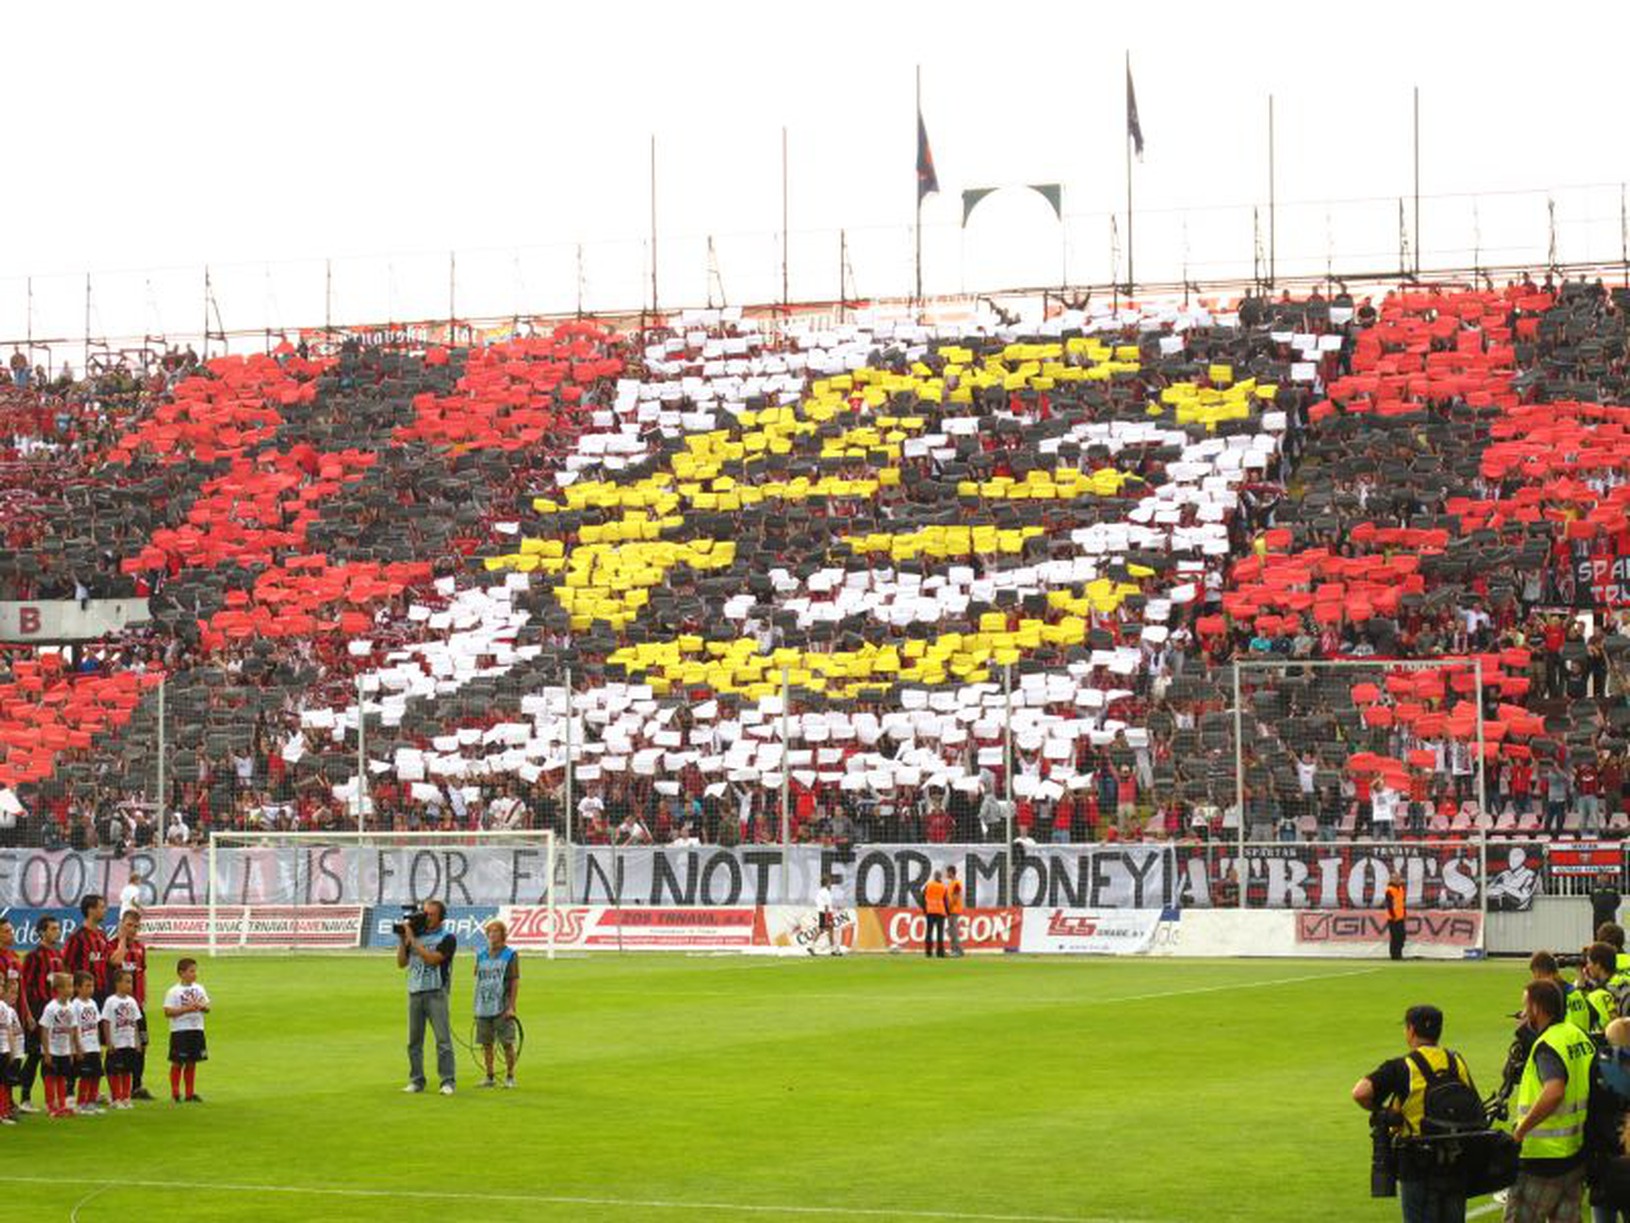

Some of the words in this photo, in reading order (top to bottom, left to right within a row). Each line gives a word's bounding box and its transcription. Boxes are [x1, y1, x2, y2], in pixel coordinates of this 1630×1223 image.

[1578, 558, 1630, 582] SPA
[19, 607, 41, 635] B
[305, 848, 343, 905] IS
[377, 849, 474, 905] FOR
[650, 851, 783, 906] NOT
[821, 850, 932, 908] FOR
[505, 908, 590, 944] ZOS
